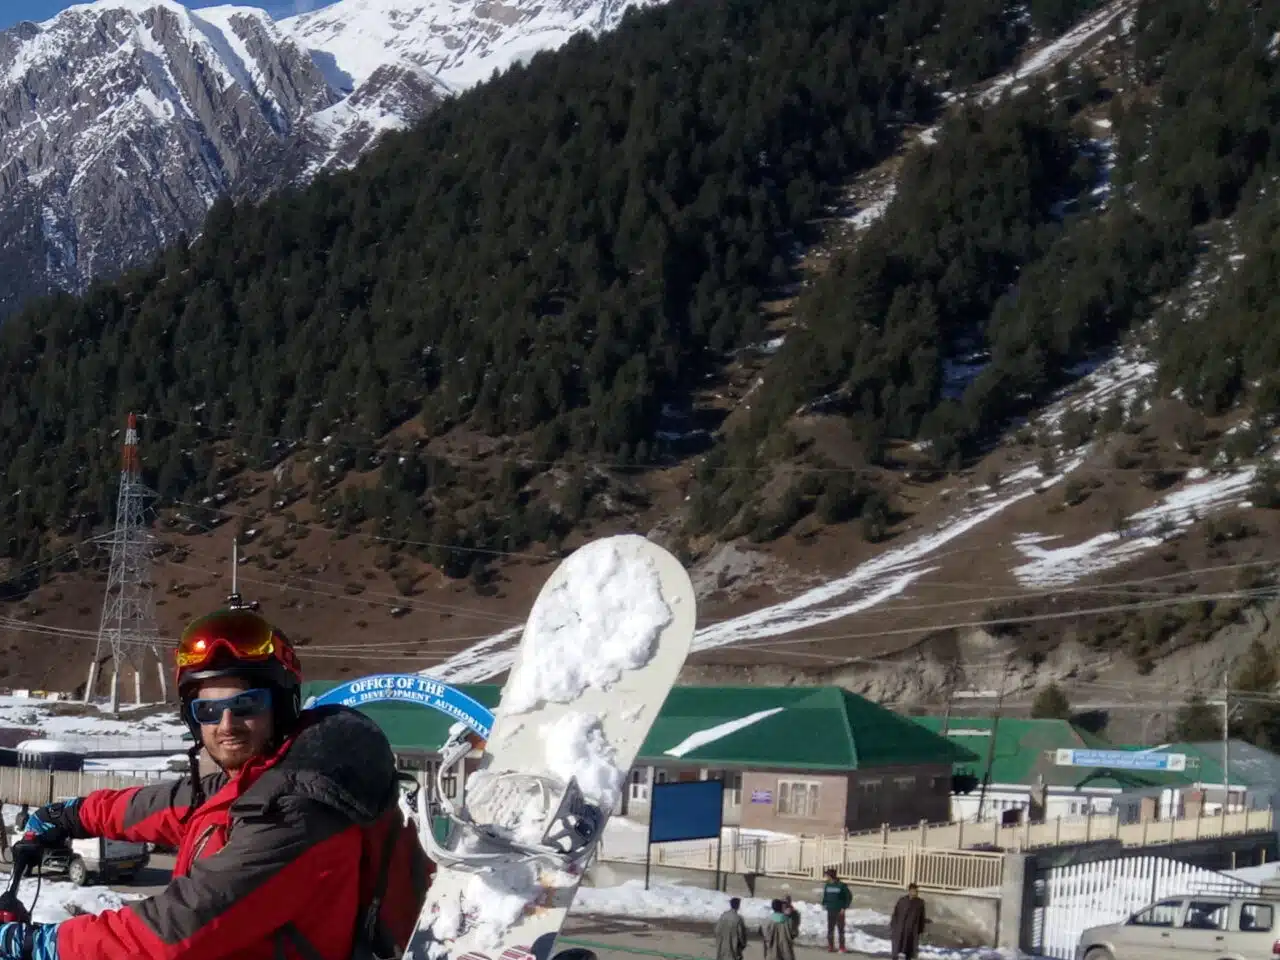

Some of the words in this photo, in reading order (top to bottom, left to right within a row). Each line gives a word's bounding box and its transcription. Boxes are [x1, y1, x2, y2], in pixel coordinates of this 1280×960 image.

[349, 677, 395, 694] OFFICE
[396, 677, 415, 689] OF
[417, 679, 444, 698] THE
[360, 689, 431, 702] DEVEPMENT
[434, 698, 490, 737] AUTHORITY
